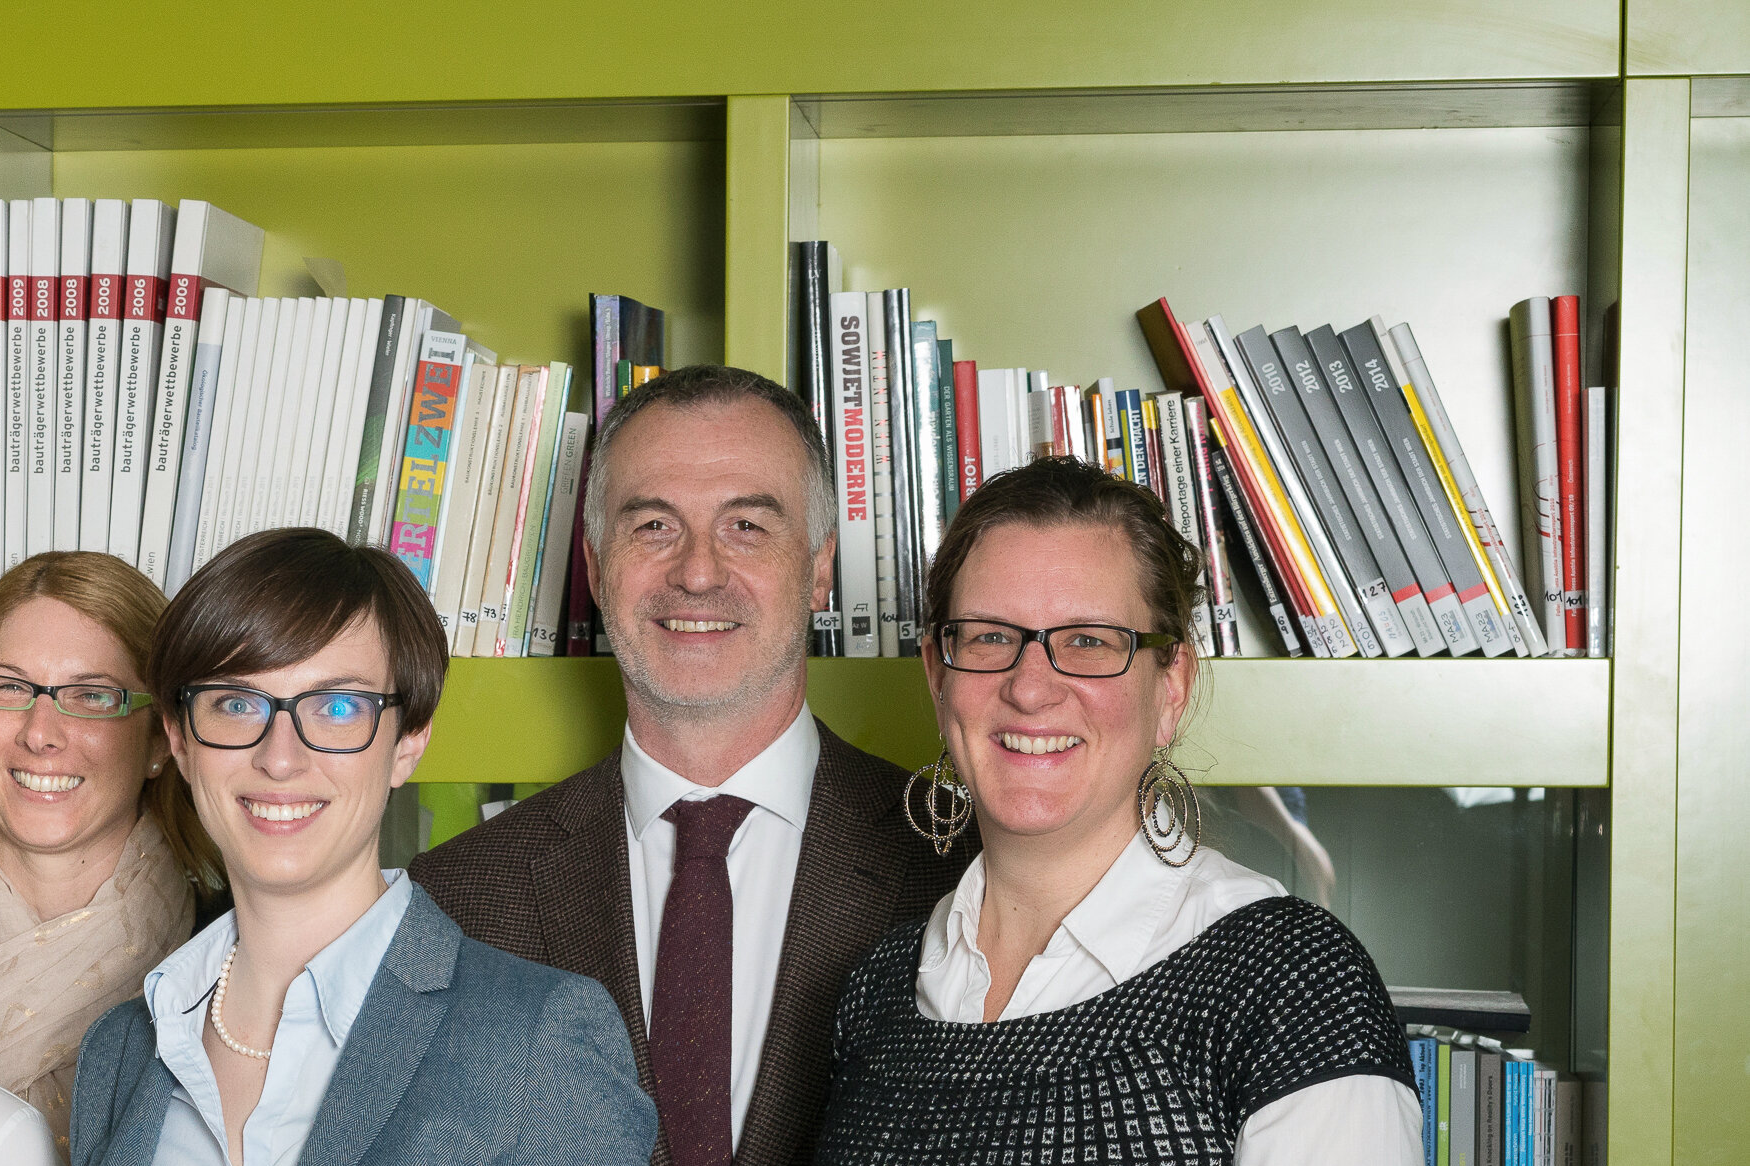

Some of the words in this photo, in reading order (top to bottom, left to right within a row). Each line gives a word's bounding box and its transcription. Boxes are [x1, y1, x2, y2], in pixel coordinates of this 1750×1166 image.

[13, 279, 24, 316] 2009
[37, 280, 48, 317] 2008
[66, 279, 77, 316] 2008
[98, 278, 110, 315] 2006
[132, 278, 146, 316] 2006
[174, 278, 188, 315] 2006
[431, 336, 457, 345] VIENNA
[872, 350, 889, 406] INTIM
[1262, 362, 1285, 395] 2010
[1296, 359, 1320, 394] 2012
[1329, 360, 1353, 394] 2013
[1365, 358, 1389, 392] 2014
[10, 326, 22, 472] bauträgerwettbewerbe
[34, 328, 46, 474] bauträgerwettbewerbe
[61, 326, 74, 472] bauträgerwettbewerbe
[90, 326, 106, 472] bauträgerwettbewerbe
[120, 326, 140, 472] bauträgerwettbewerbe
[156, 326, 182, 472] bauträgerwettbewerbe
[414, 347, 455, 448] ZWEI
[944, 400, 952, 428] GARTEN
[1167, 399, 1178, 445] Karriere
[566, 427, 577, 458] GREEN
[875, 419, 891, 465] WIEN
[1408, 451, 1421, 466] STADT
[946, 444, 955, 492] WISSENSRAUM
[1173, 445, 1184, 474] einer
[1307, 453, 1320, 468] STADT
[1314, 469, 1324, 479] DER
[1340, 452, 1353, 467] STADT
[1347, 468, 1357, 478] DER
[1372, 452, 1386, 467] STADT
[1380, 468, 1390, 478] DER
[1415, 467, 1425, 477] DER
[1177, 476, 1192, 538] Reportage
[1223, 475, 1244, 511] Bürgerkrieg
[1319, 480, 1337, 505] JAHRBUCH
[1352, 479, 1370, 504] JAHRBUCH
[1384, 479, 1402, 504] JAHRBUCH
[1420, 478, 1438, 503] JAHRBUCH
[397, 454, 440, 572] ERTEL
[1244, 529, 1262, 562] Aussichten
[1257, 563, 1278, 603] Enzensberger
[1544, 590, 1562, 603] 101
[462, 612, 477, 623] 78
[484, 607, 497, 619] 73
[815, 616, 840, 628] 107
[1217, 608, 1232, 621] 31
[532, 627, 558, 643] 130
[901, 623, 912, 637] 5
